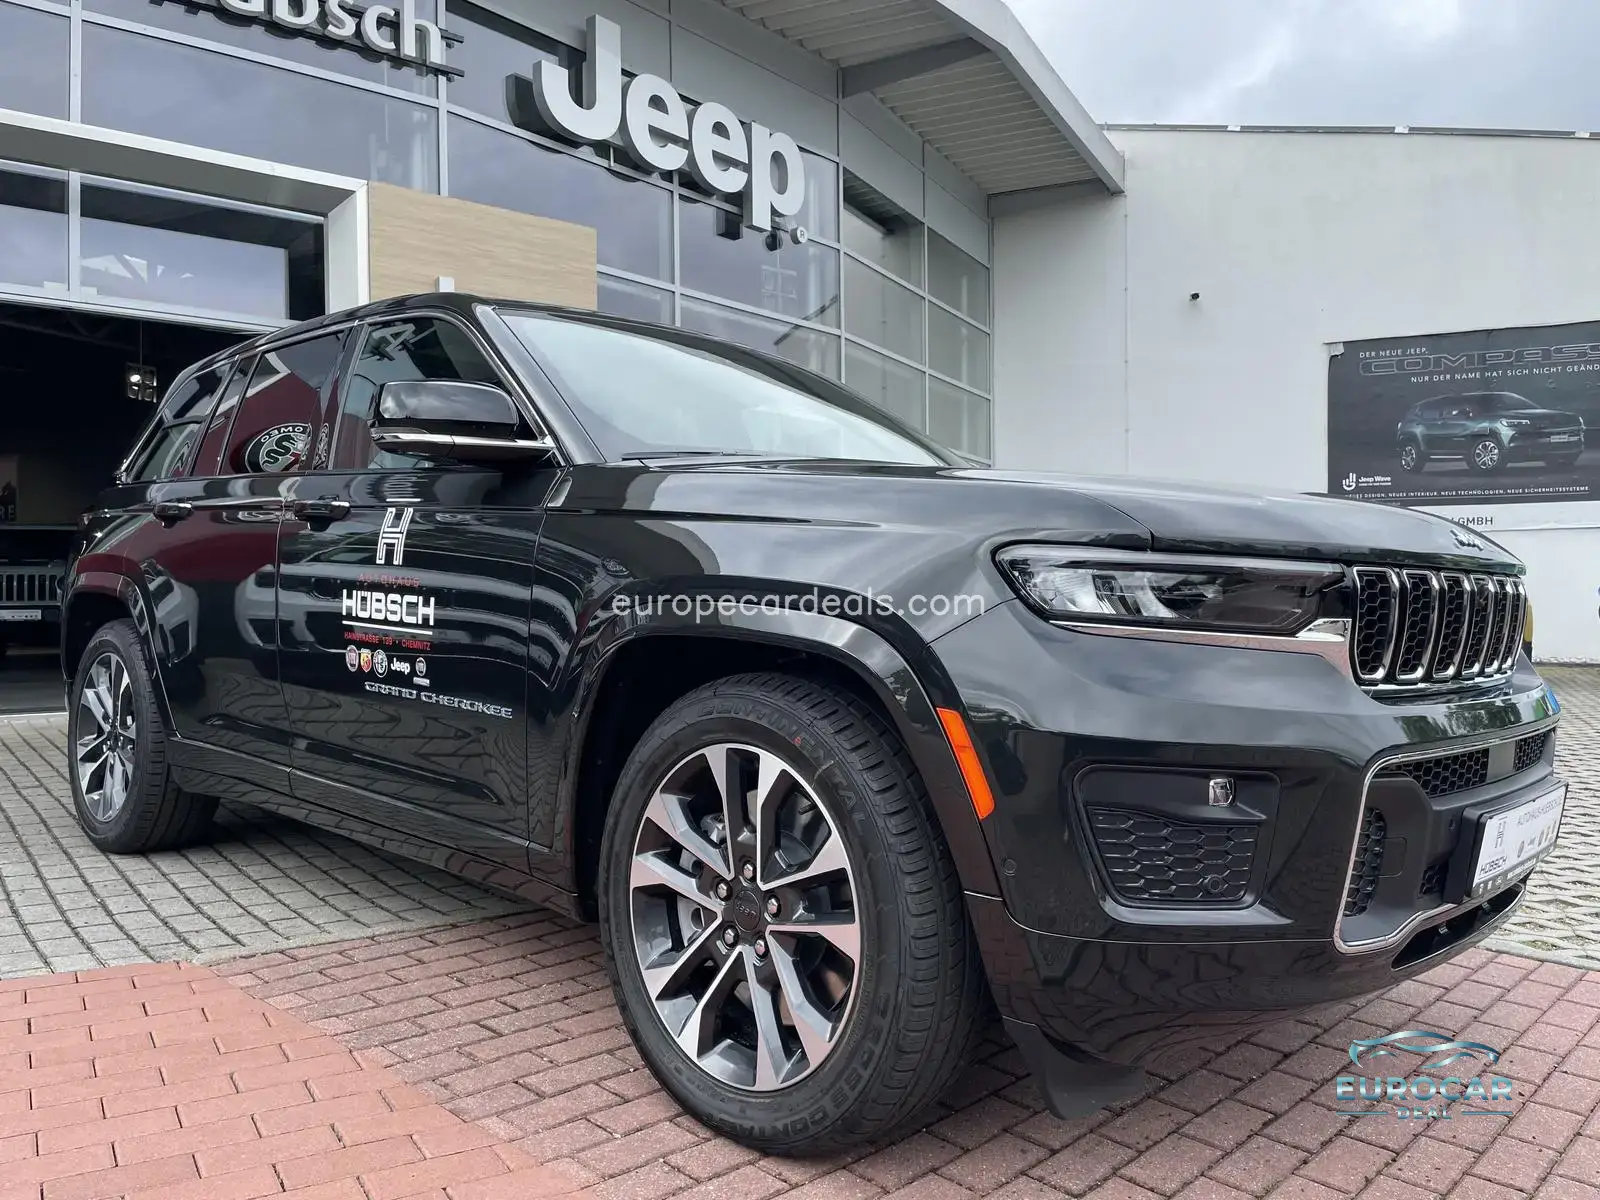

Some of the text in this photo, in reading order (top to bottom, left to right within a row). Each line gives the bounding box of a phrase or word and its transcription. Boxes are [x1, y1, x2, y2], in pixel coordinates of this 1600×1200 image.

[532, 14, 806, 231] Jeep
[1455, 372, 1480, 380] NAME
[1485, 370, 1503, 378] HAT
[1507, 368, 1529, 376] SICH
[1533, 366, 1562, 375] NICHT
[1458, 516, 1493, 526] GMBH
[342, 589, 435, 626] HÜBSCH
[401, 639, 431, 651] CHEMNITZ
[390, 657, 411, 676] Jeep
[364, 681, 418, 699] GRAND
[420, 691, 513, 719] CHEROKEE
